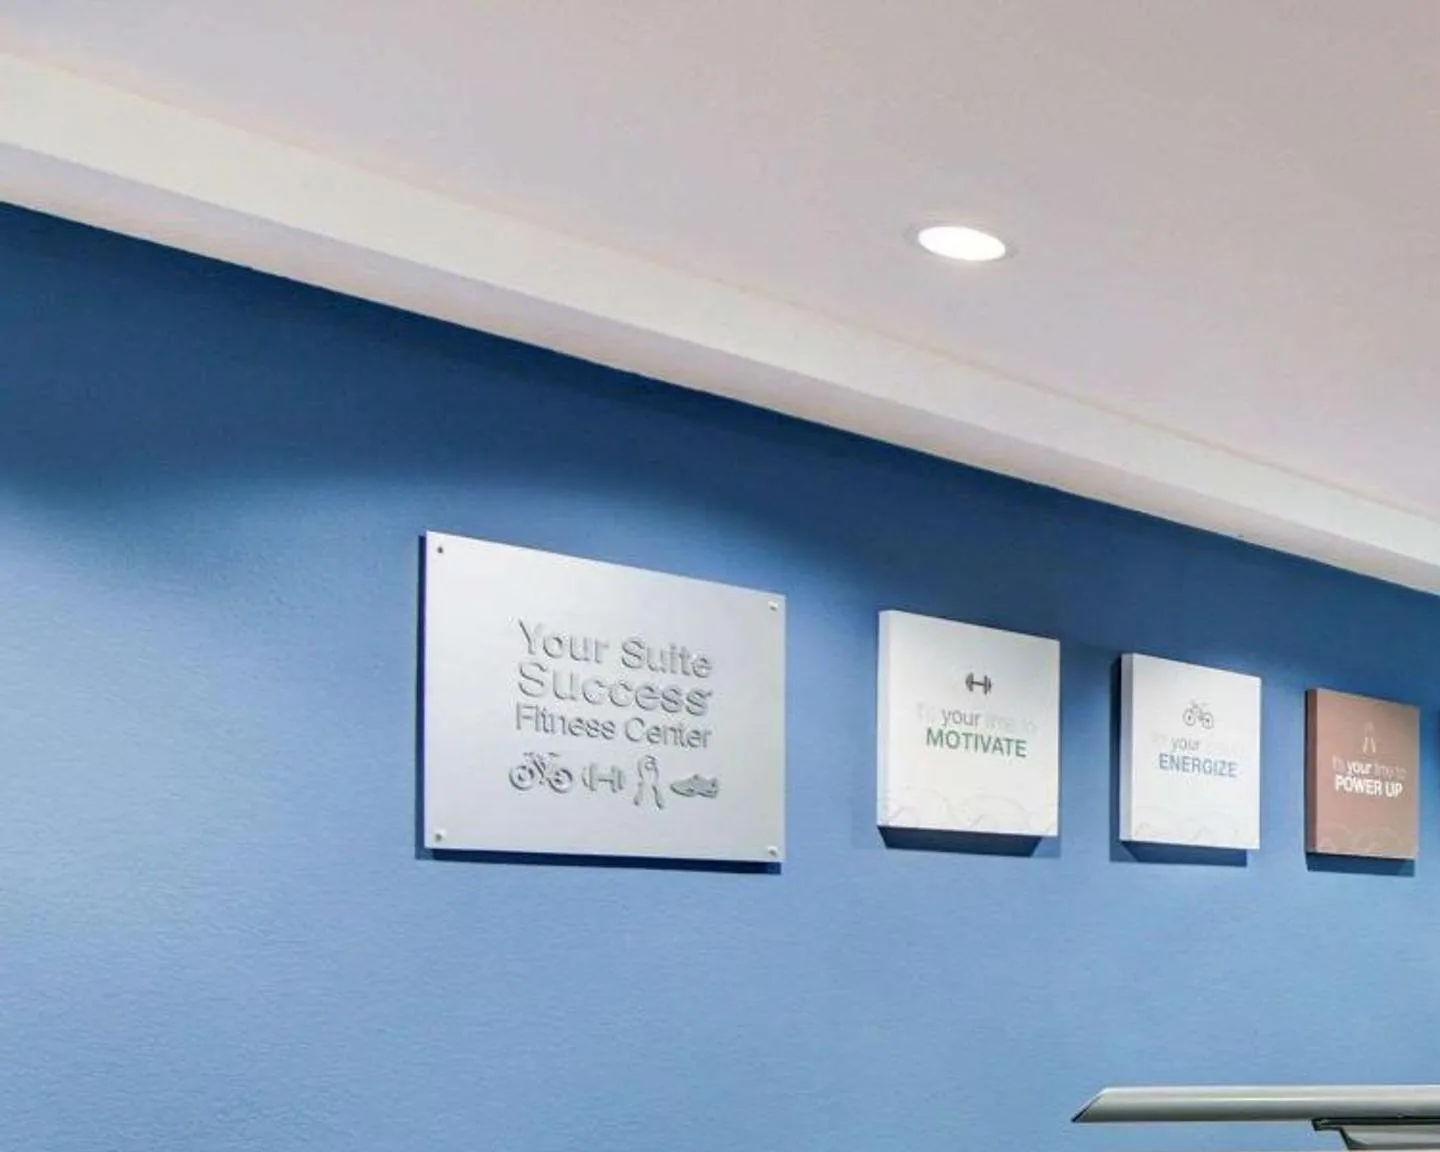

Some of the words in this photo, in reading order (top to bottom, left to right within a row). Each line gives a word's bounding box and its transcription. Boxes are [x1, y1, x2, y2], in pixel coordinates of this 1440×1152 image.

[513, 617, 609, 664] Your
[621, 634, 713, 678] Suite
[517, 662, 713, 717] Success
[515, 701, 617, 741] Fitness
[625, 716, 712, 750] Center
[941, 708, 982, 727] your
[926, 727, 1028, 758] MOTIVATE
[1159, 752, 1238, 778] ENERGIZE
[1335, 774, 1383, 796] POWER
[1385, 780, 1404, 798] UP
